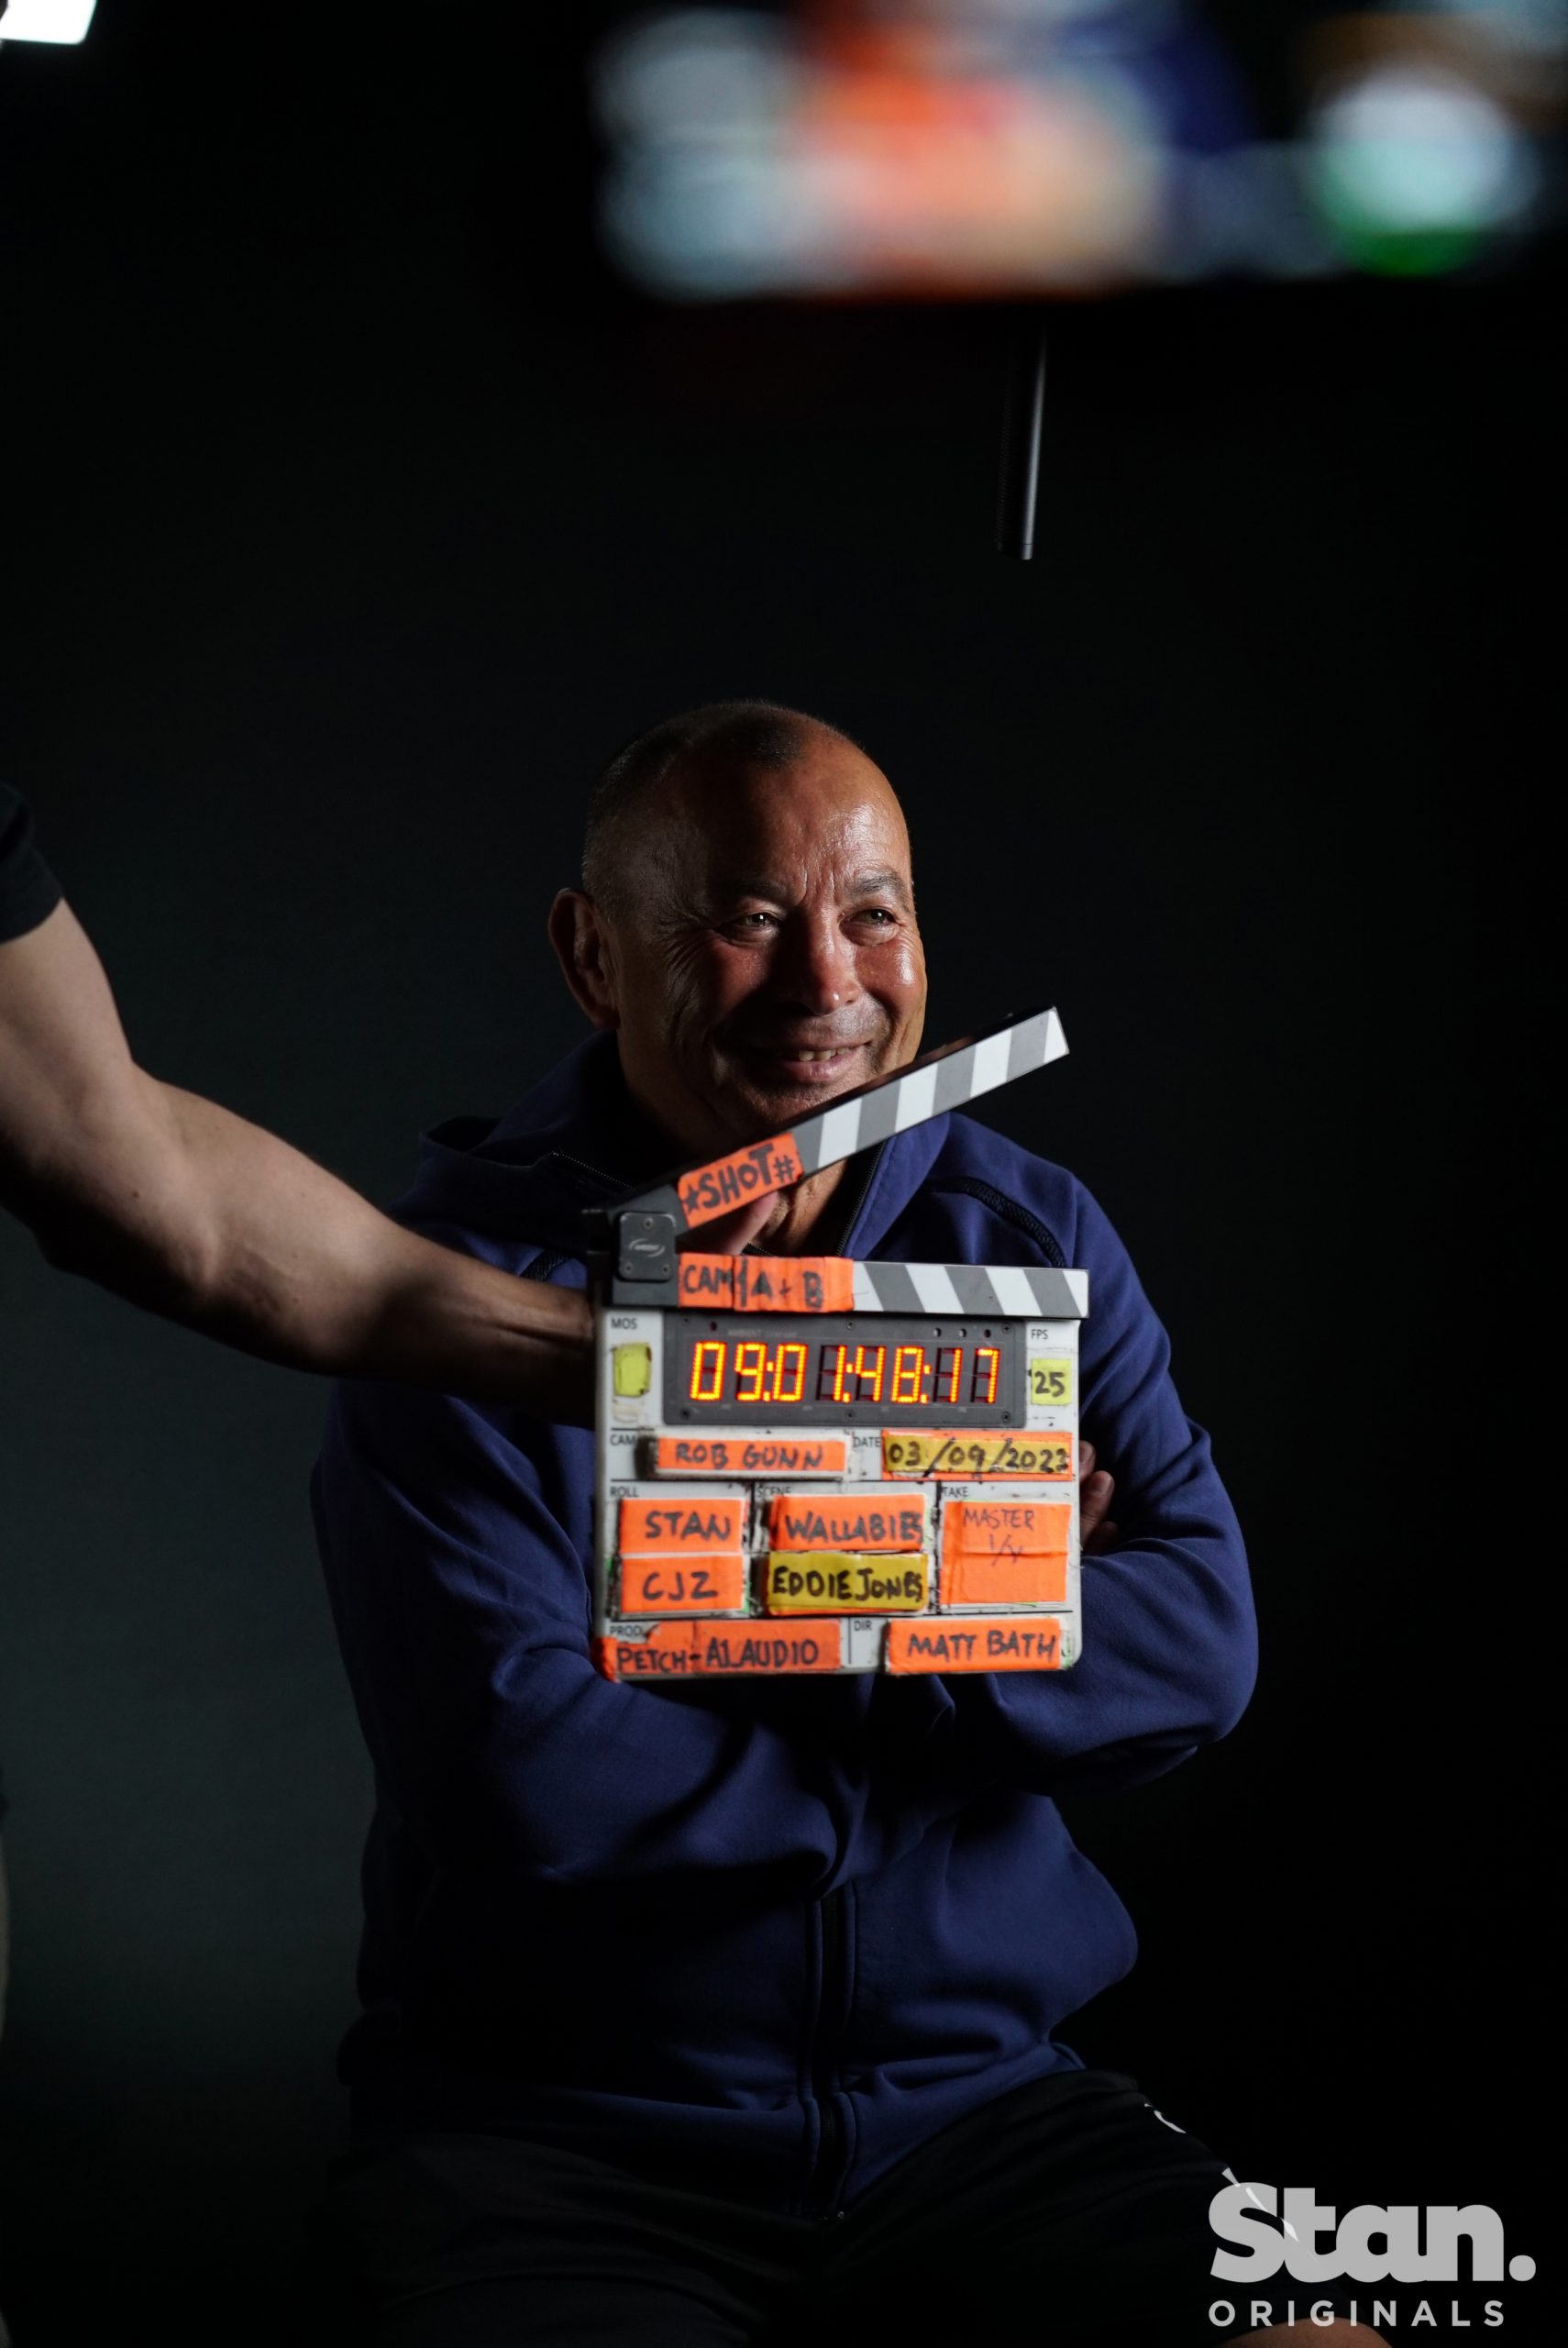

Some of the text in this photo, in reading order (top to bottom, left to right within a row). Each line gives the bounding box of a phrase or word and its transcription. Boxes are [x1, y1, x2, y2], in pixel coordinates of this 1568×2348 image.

[612, 1317, 637, 1329] MOS
[1032, 1329, 1048, 1340] FPS
[1034, 1370, 1066, 1398] 25
[853, 1436, 881, 1448] DATE
[676, 1443, 823, 1470] ROB GUNN
[610, 1486, 638, 1498] ROLL
[943, 1486, 968, 1498] TAKE
[645, 1511, 731, 1541] STAN
[963, 1508, 1034, 1531] MASTER
[643, 1571, 718, 1600] CJZ
[772, 1566, 852, 1600] EDDIE
[854, 1620, 872, 1631] DIR
[908, 1630, 1055, 1662] MATT BATH
